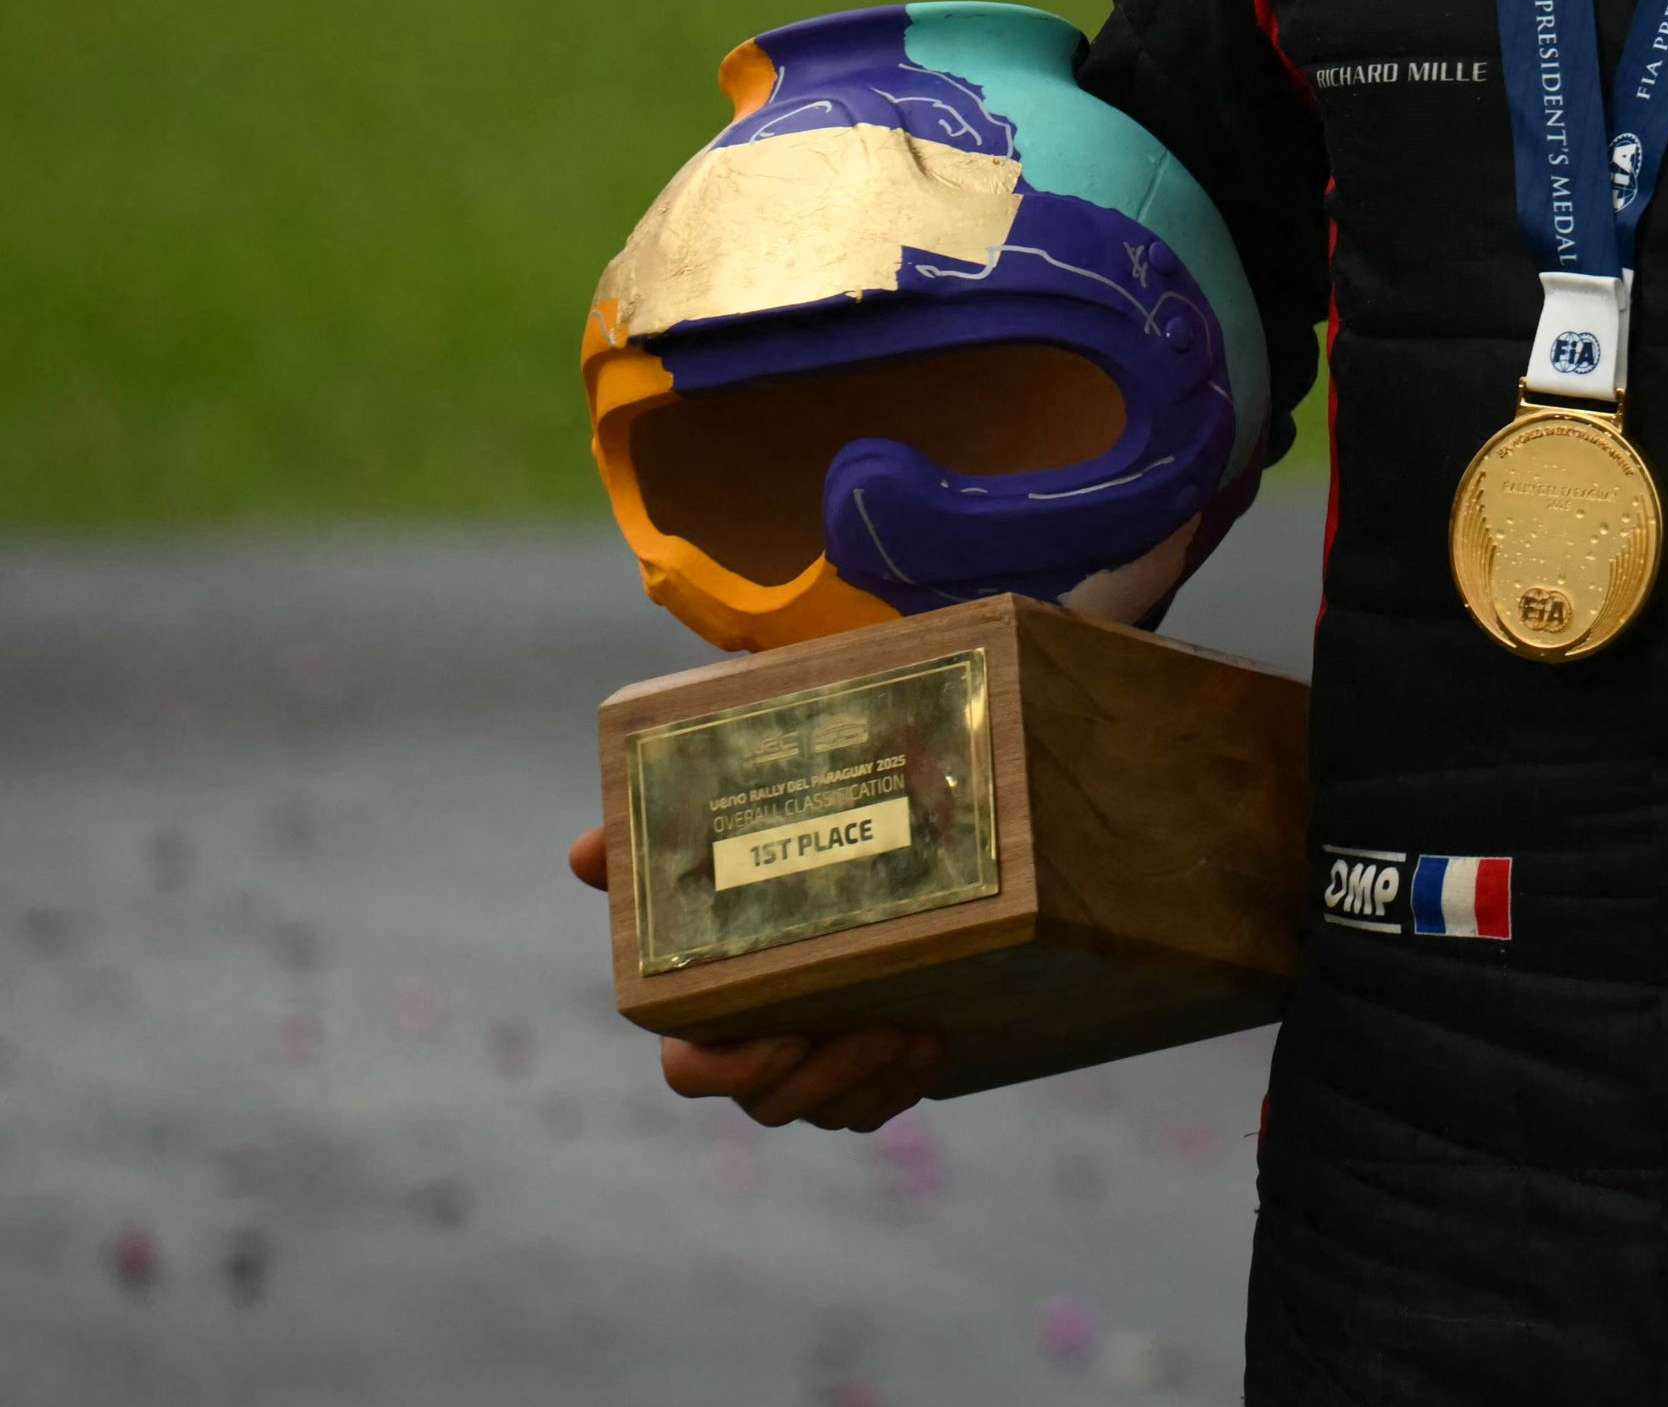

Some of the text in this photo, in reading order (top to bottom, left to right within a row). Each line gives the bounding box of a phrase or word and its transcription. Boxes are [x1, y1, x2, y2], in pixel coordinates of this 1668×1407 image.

[1316, 62, 1488, 87] RICHARD MILLE
[1535, 0, 1570, 165] PRESIDENT'S
[1637, 58, 1664, 101] FIA
[1549, 176, 1578, 267] MEDAL
[750, 783, 788, 803] RALLY
[787, 778, 810, 795] DEL
[811, 762, 874, 788] PARAGUAY
[876, 754, 907, 772] 2025
[749, 818, 874, 867] 1ST PLACE
[1325, 858, 1399, 918] OMP
